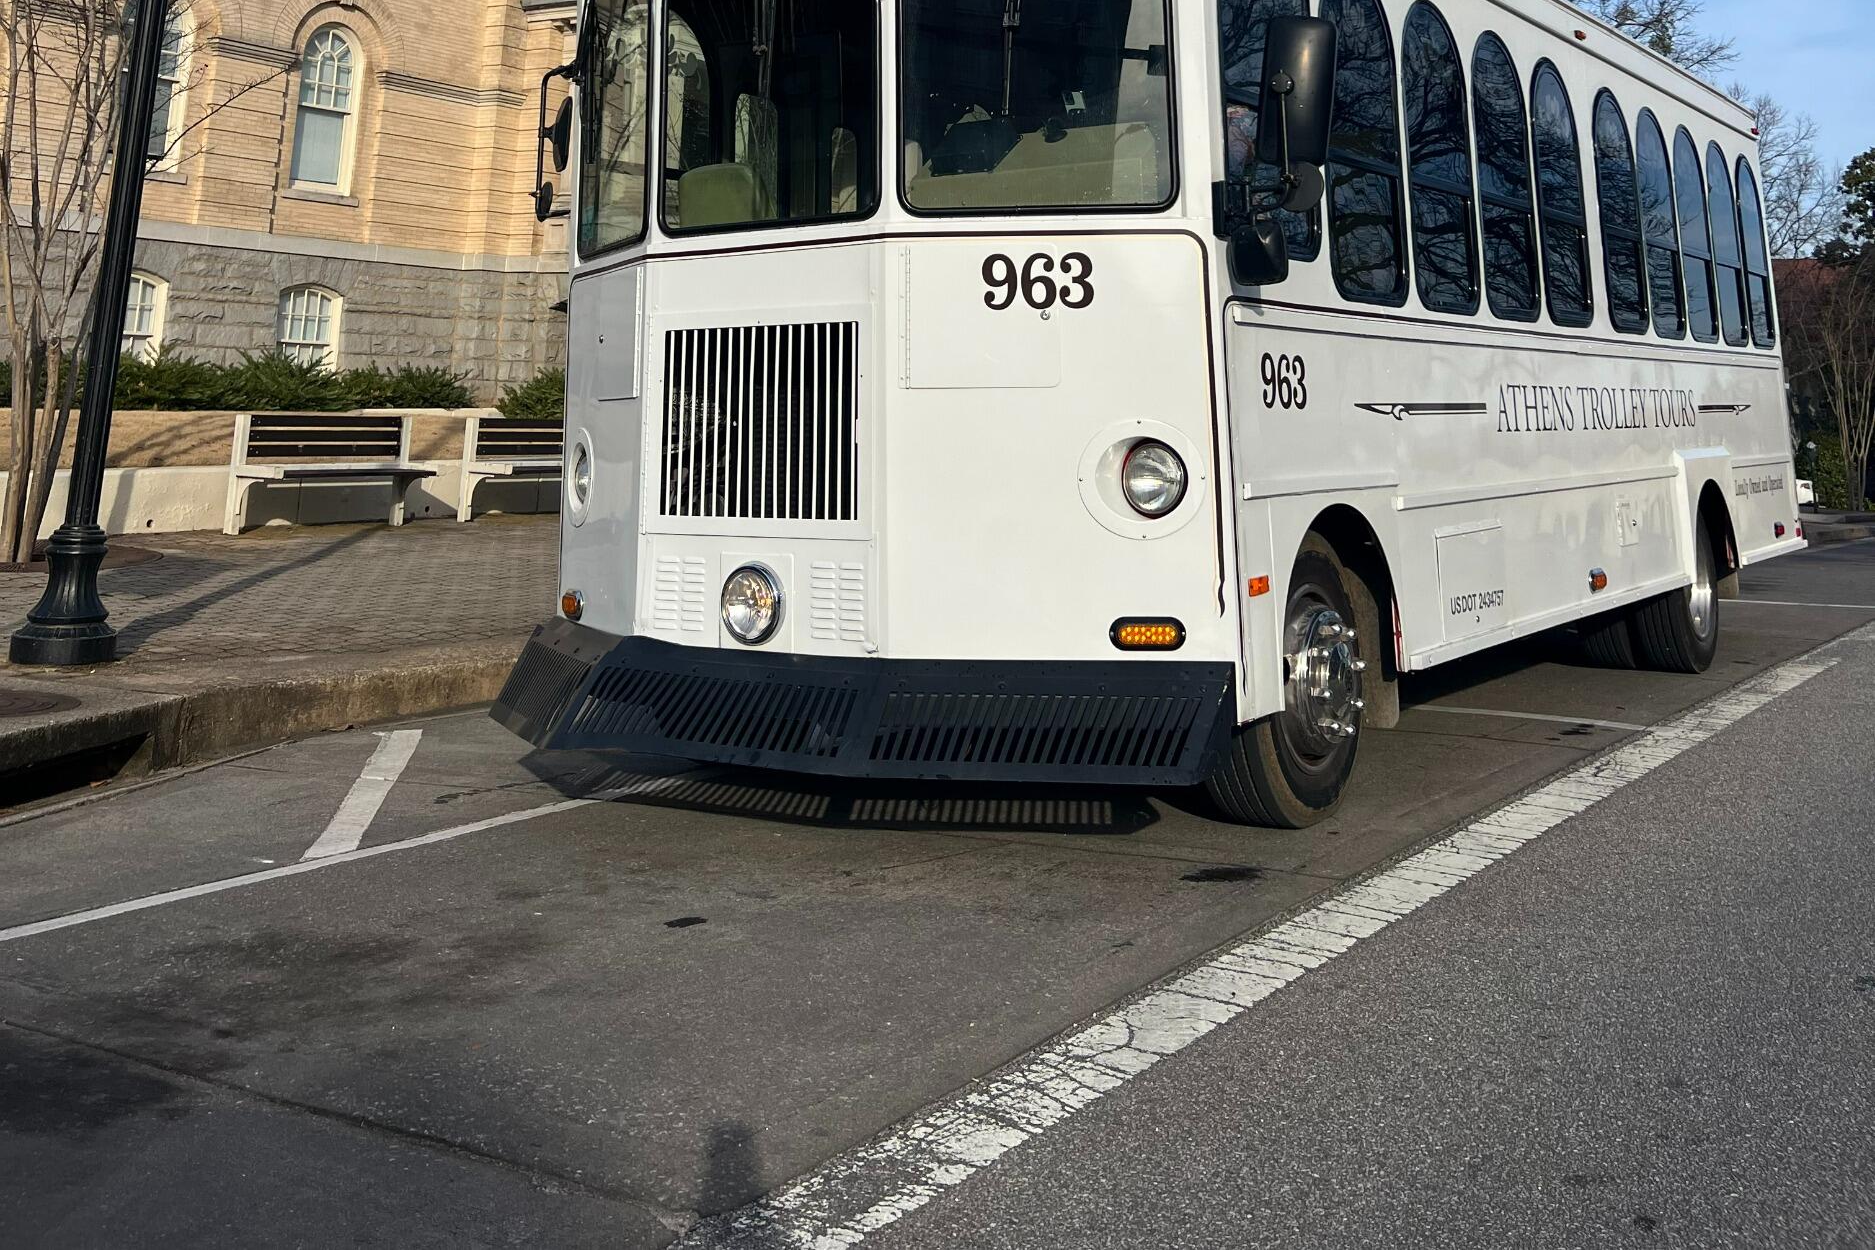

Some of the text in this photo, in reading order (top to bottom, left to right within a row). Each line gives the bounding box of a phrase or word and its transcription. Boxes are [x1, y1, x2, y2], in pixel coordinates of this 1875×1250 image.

[981, 251, 1095, 311] 963
[1261, 352, 1307, 410] 963
[1497, 383, 1696, 432] ATHENS TROLLEY TOURS
